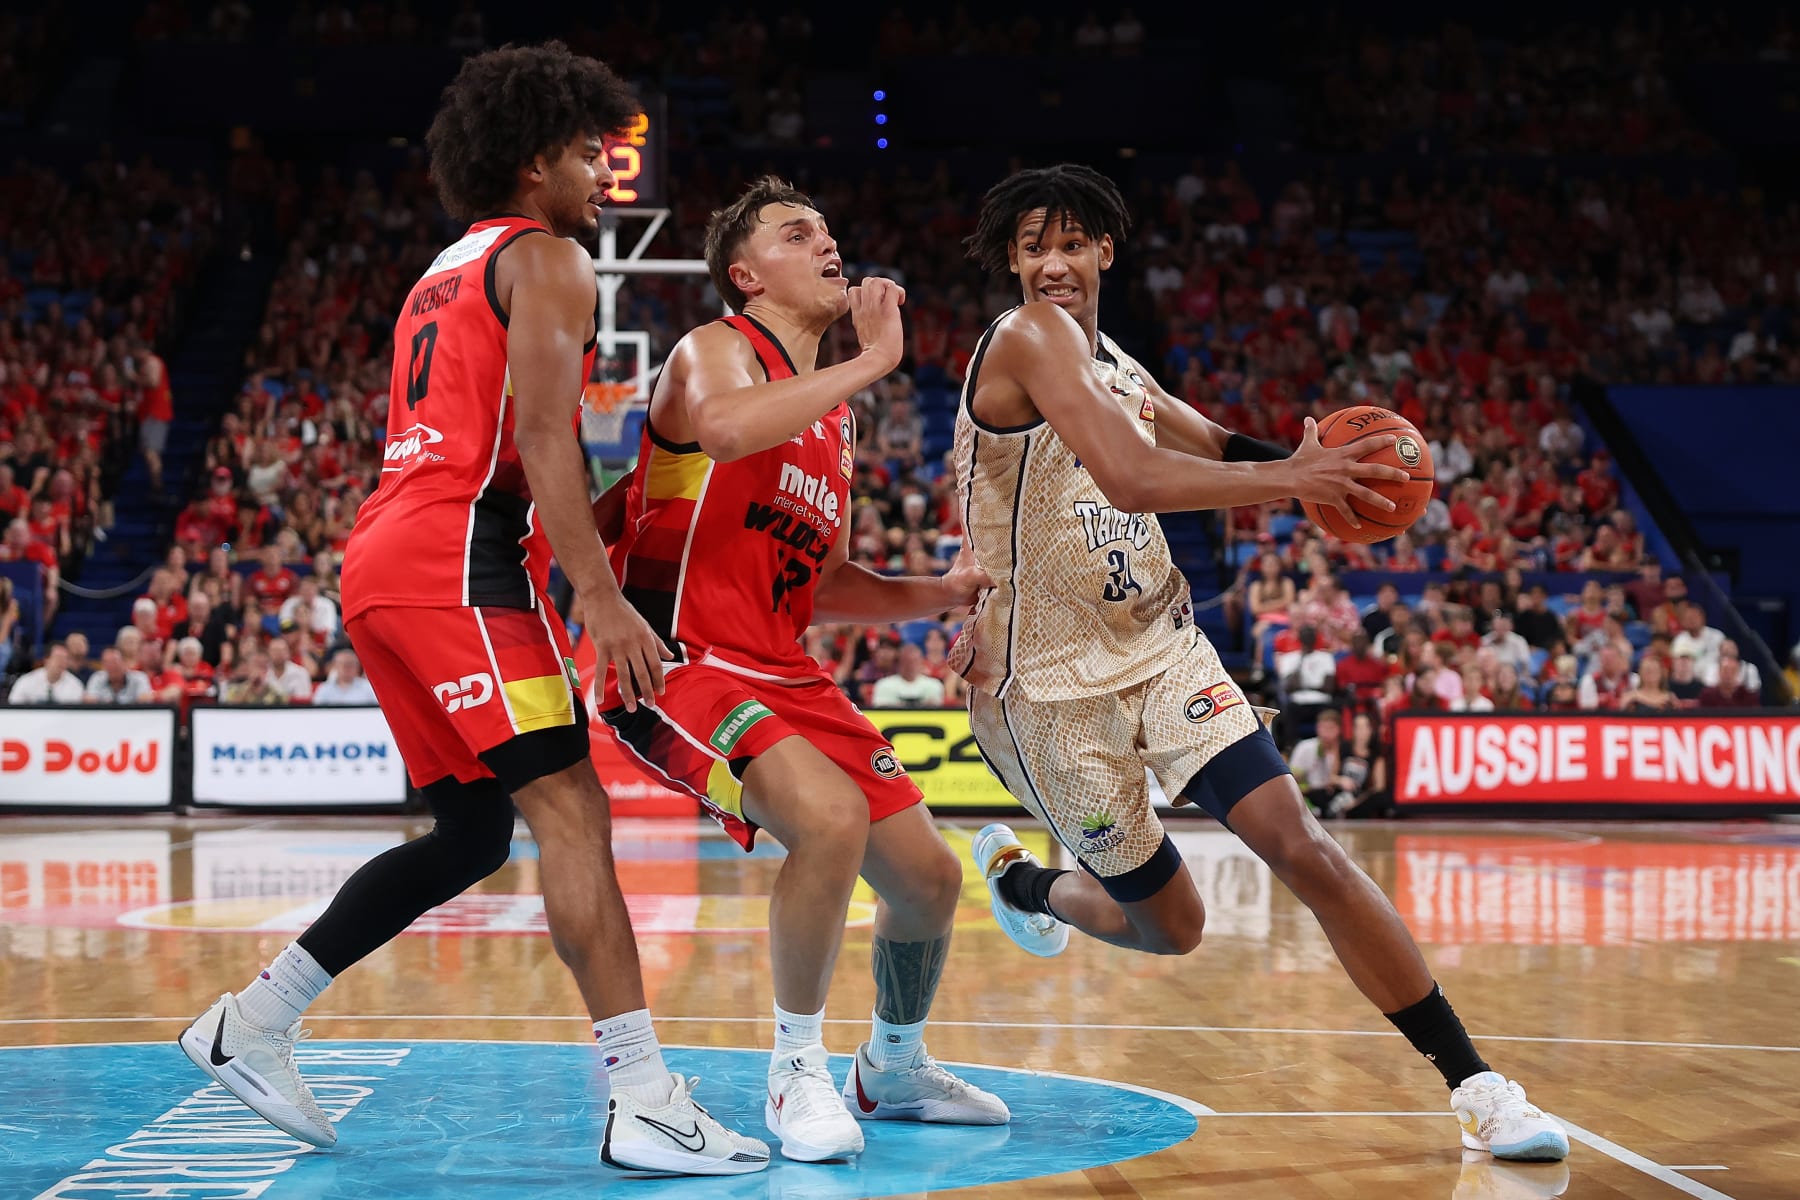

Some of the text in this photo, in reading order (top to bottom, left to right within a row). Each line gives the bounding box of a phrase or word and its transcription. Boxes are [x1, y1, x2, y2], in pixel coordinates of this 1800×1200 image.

[602, 146, 641, 203] 2
[410, 275, 463, 317] WEBSTER
[406, 320, 439, 412] 0
[773, 492, 808, 518] internet
[778, 461, 841, 528] mate.
[1102, 549, 1143, 603] 34
[718, 703, 769, 746] HOLMAN
[1189, 699, 1211, 718] NBL
[43, 739, 159, 775] Dodd
[211, 742, 388, 762] McMAHON
[877, 756, 895, 772] NBL
[1405, 723, 1589, 799] AUSSIE
[1079, 830, 1125, 851] Cairns
